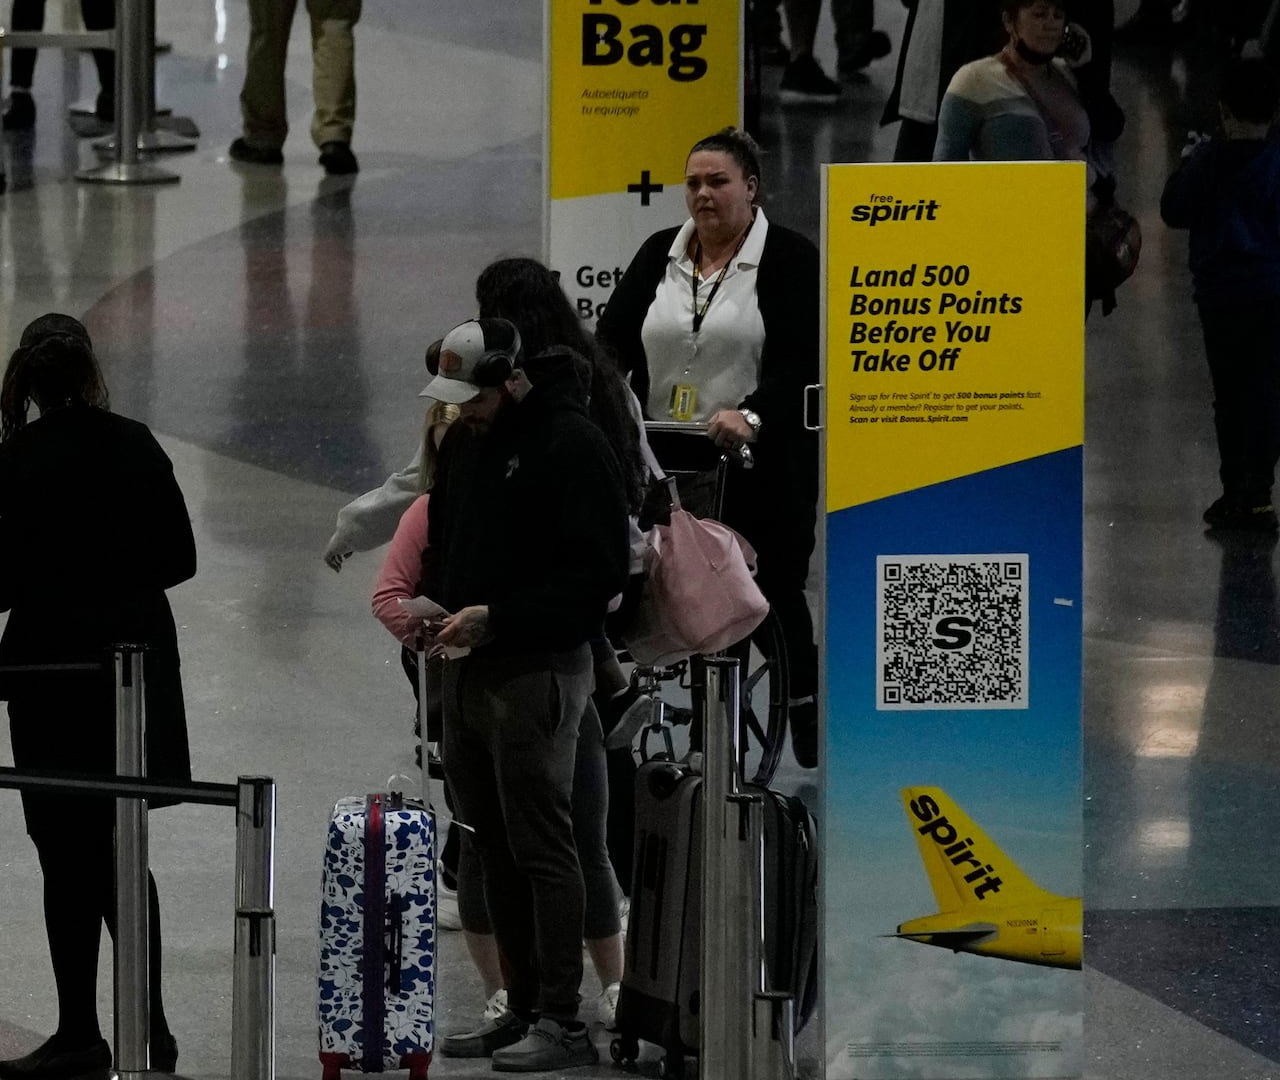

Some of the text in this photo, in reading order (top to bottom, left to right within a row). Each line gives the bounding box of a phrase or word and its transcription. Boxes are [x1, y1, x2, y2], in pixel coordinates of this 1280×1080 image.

[581, 13, 708, 82] Bag
[581, 88, 649, 101] Autoetiqueta
[582, 105, 640, 118] tu equipaje
[870, 193, 894, 203] free
[850, 199, 940, 226] spirit
[576, 265, 624, 288] Get
[850, 263, 970, 288] Land 500
[849, 290, 1023, 316] Bonus Points
[849, 320, 991, 344] Before You
[851, 347, 961, 372] Take Off
[849, 393, 866, 402] Sign
[868, 394, 878, 402] up
[892, 392, 908, 400] Free
[933, 392, 941, 400] to
[943, 392, 955, 401] get
[956, 392, 972, 400] 500
[973, 391, 998, 399] bonus
[999, 391, 1025, 400] points
[849, 404, 878, 413] Already
[886, 404, 922, 412] member?
[923, 403, 954, 412] Register
[956, 403, 964, 411] to
[965, 404, 978, 412] get
[979, 404, 997, 412] your
[998, 402, 1025, 411] points.
[849, 415, 869, 423] Scan
[881, 414, 898, 423] visit
[909, 794, 1003, 901] spirit
